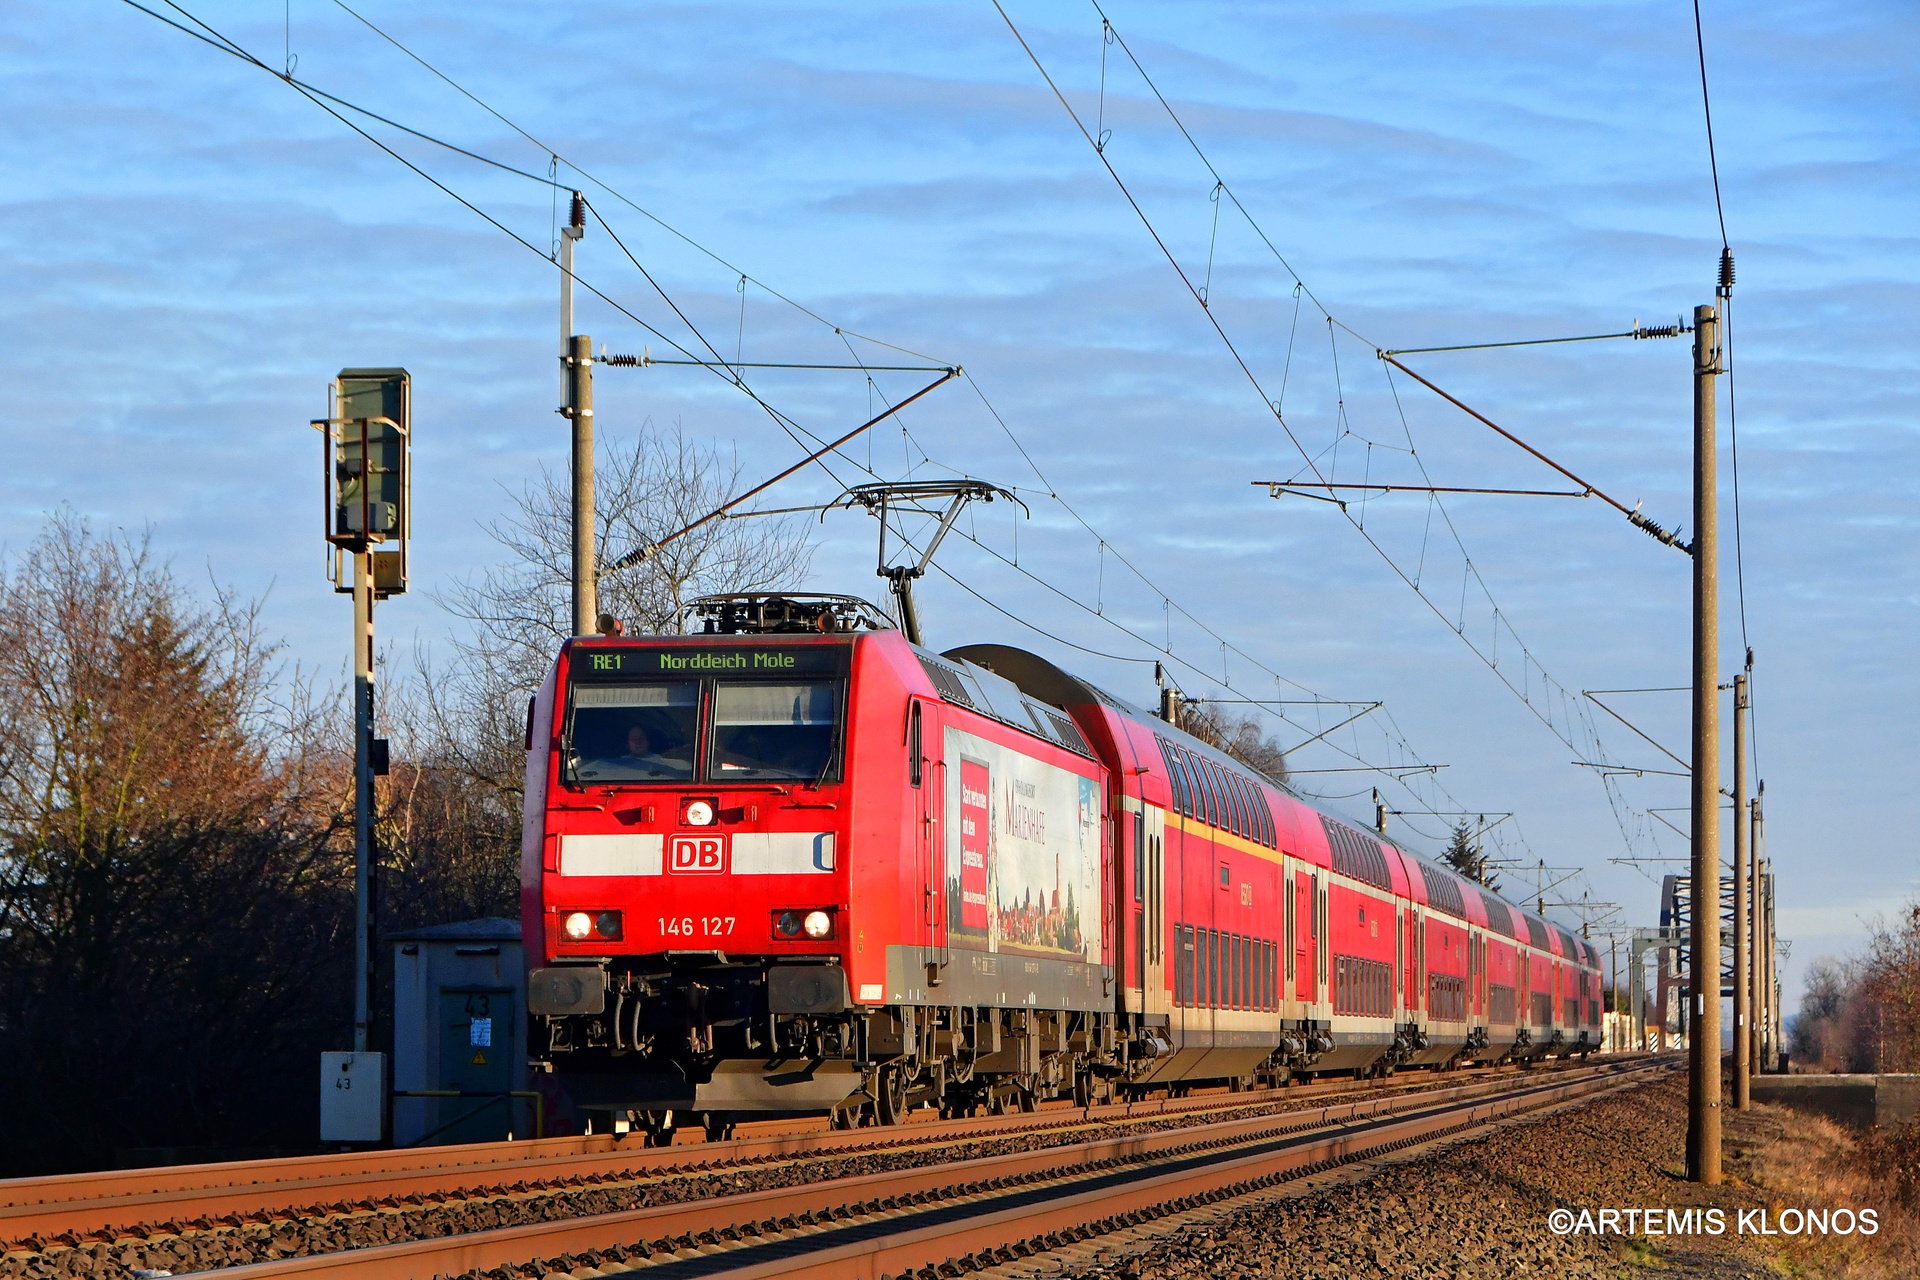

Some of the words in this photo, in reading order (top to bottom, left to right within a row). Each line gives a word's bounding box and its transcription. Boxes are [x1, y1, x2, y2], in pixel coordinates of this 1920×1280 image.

[593, 654, 622, 670] RE1
[660, 653, 747, 670] Norddeich
[754, 652, 795, 668] Mole
[675, 840, 720, 868] DB
[657, 917, 694, 936] 146
[701, 916, 736, 936] 127
[465, 993, 490, 1017] 43
[335, 1078, 351, 1091] 43
